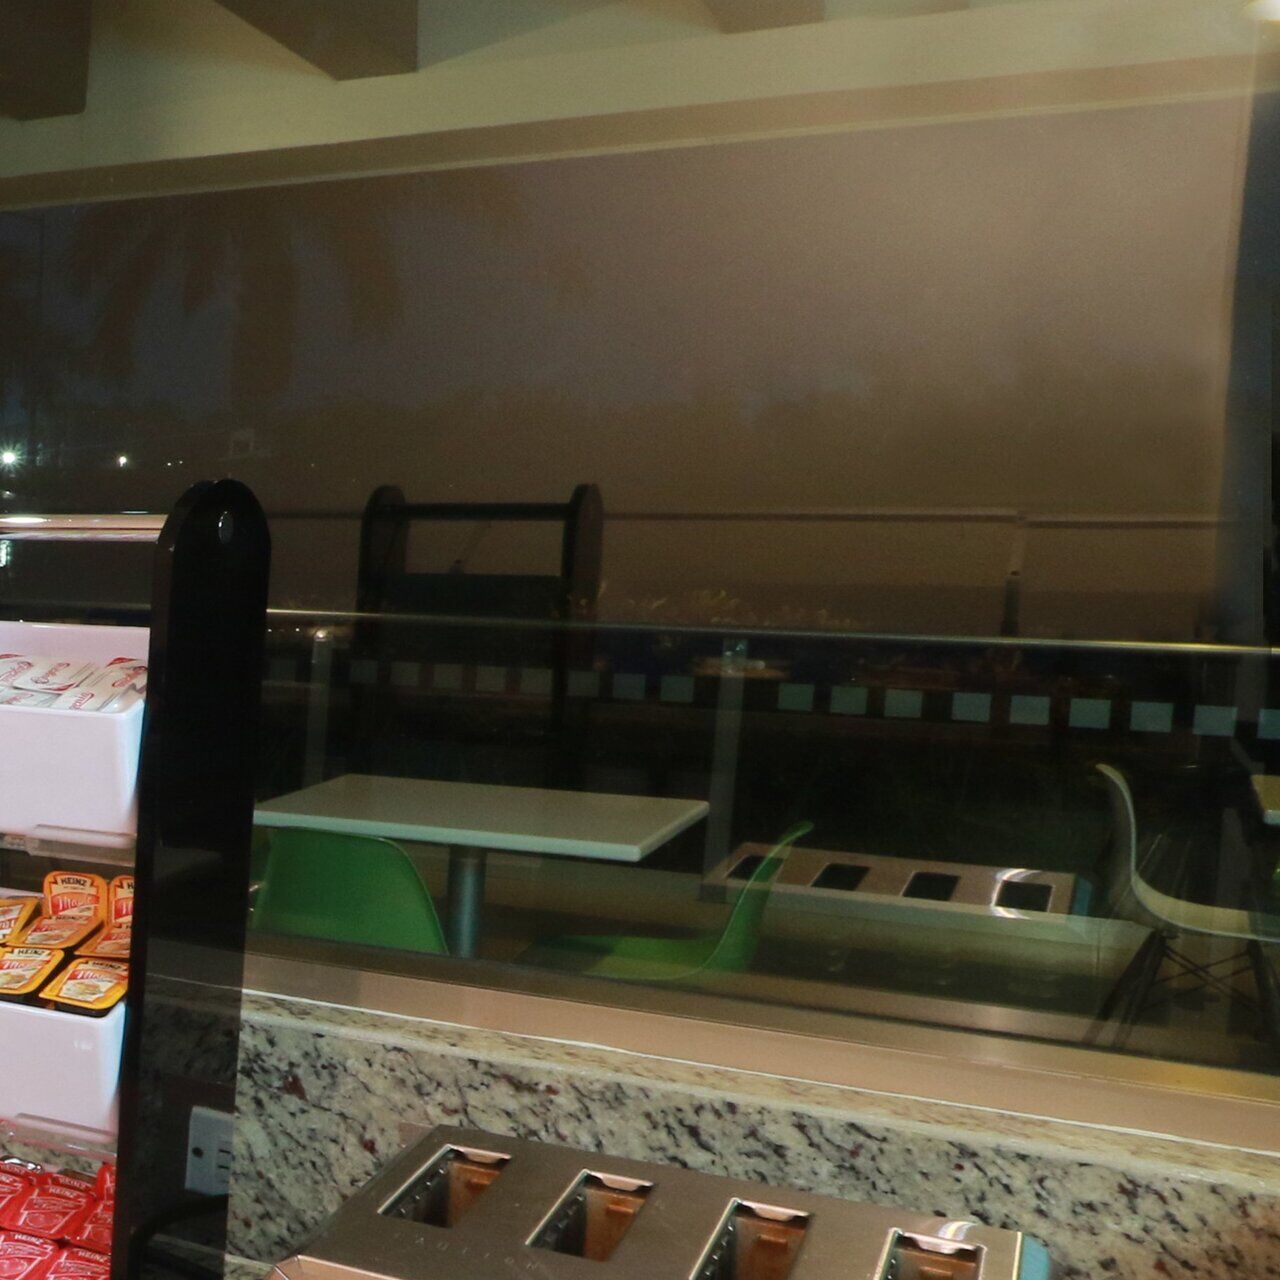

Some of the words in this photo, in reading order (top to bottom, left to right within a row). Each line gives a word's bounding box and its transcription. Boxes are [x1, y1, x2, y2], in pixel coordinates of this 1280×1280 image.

[61, 877, 87, 887] HEINZ
[91, 960, 123, 970] HEINZ
[49, 1186, 77, 1198] HEINZ
[14, 1233, 44, 1244] HEINZ
[78, 1250, 108, 1262] HEINZ
